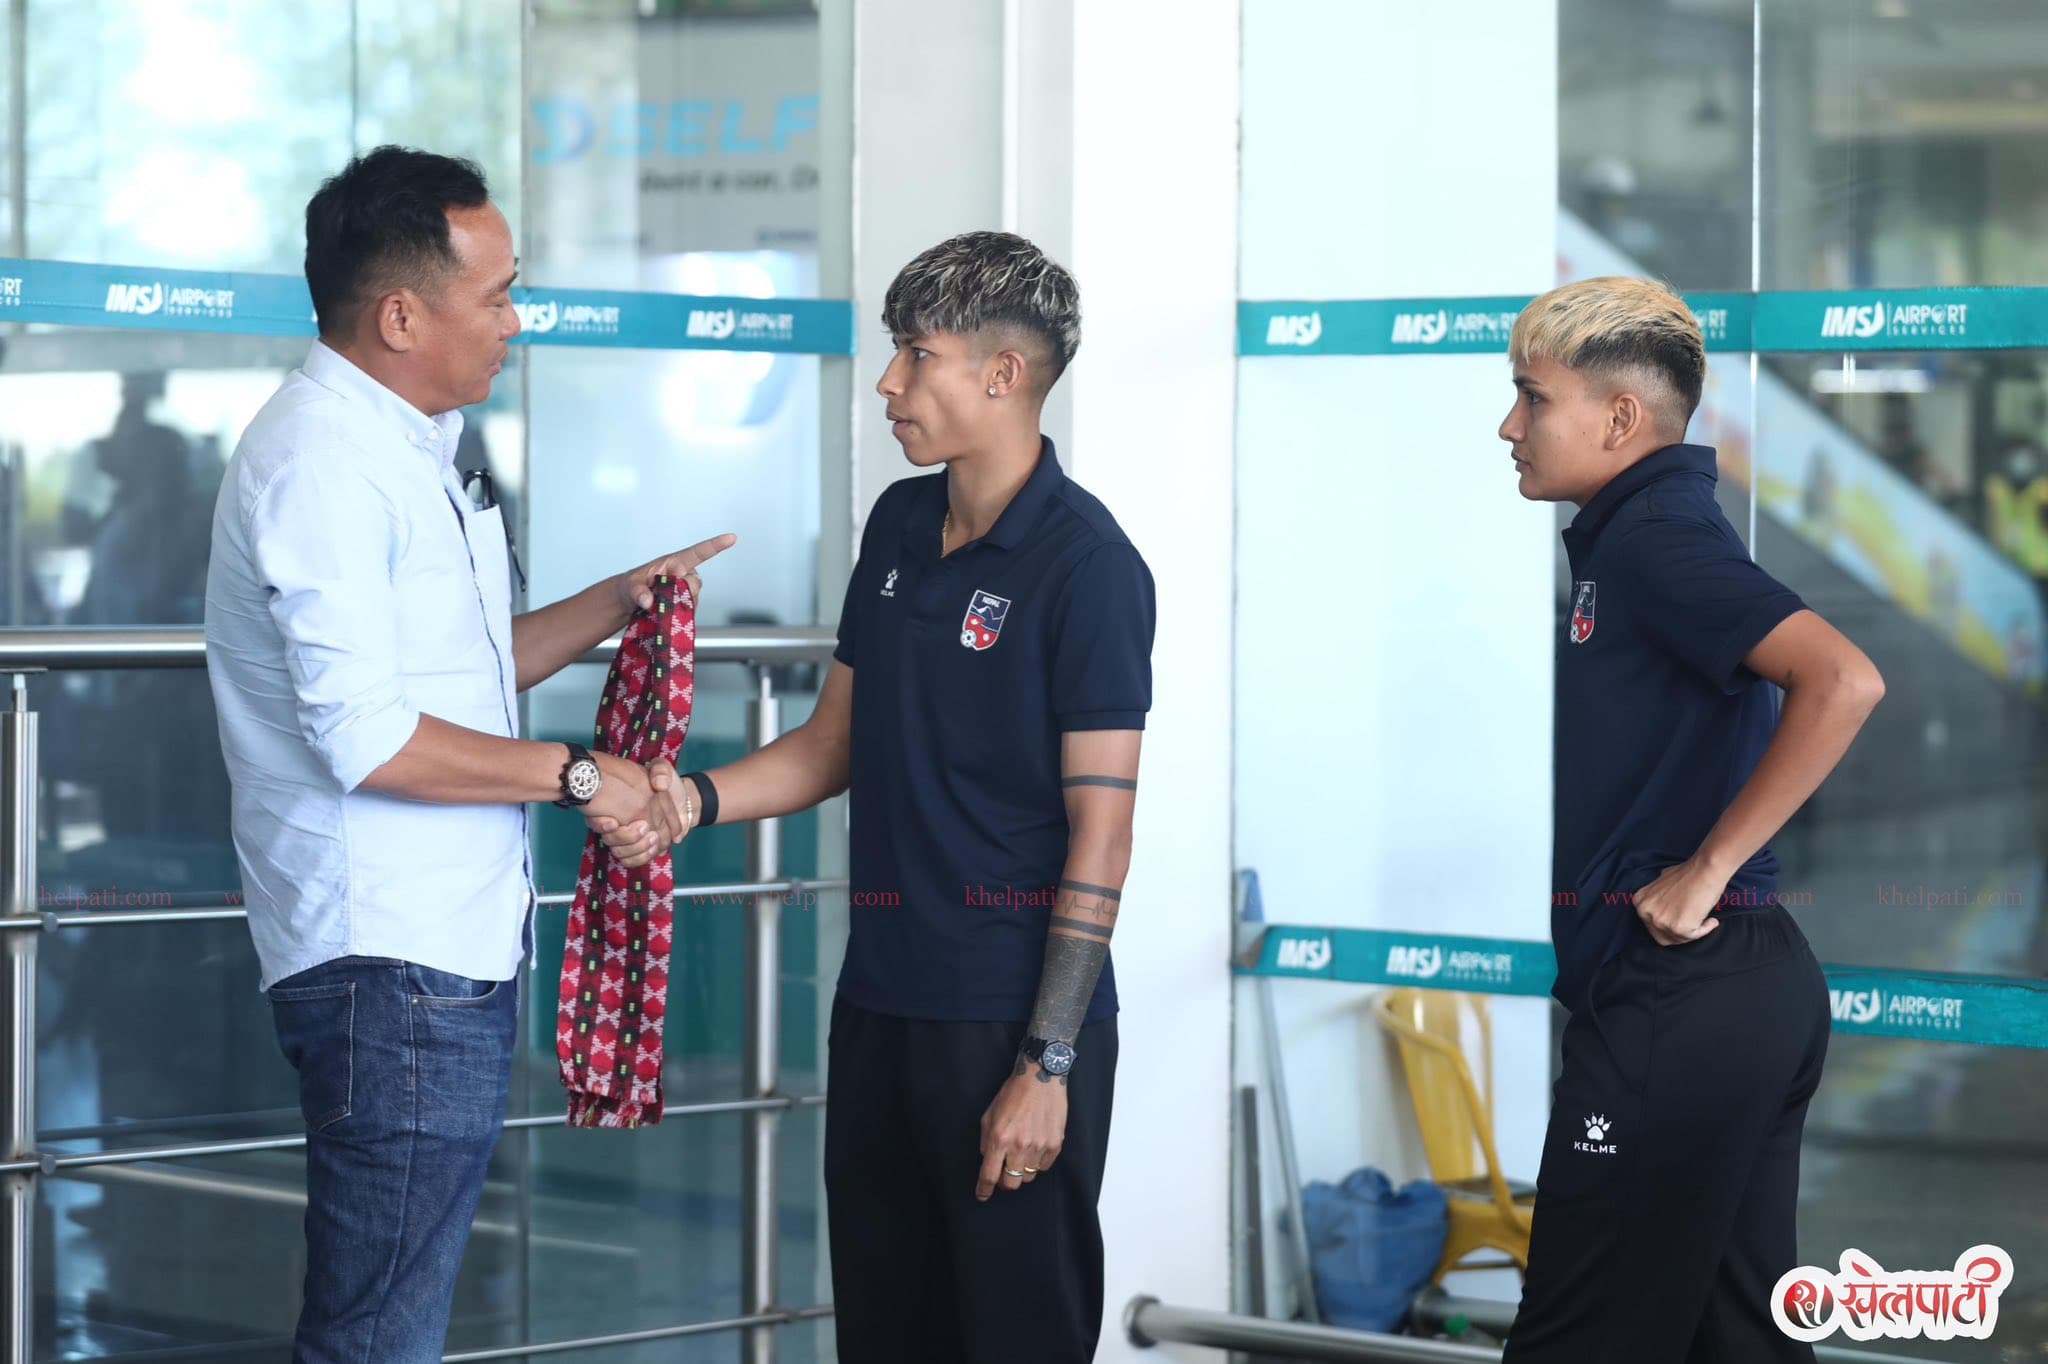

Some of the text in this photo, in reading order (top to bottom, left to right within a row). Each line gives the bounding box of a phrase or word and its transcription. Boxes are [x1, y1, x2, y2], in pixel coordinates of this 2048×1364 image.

[607, 95, 821, 158] SELF
[170, 287, 235, 309] AIRPORT
[1893, 304, 1968, 325] AIRPORT
[1892, 323, 1967, 336] SERVICES
[1830, 988, 1963, 1024] MS AIRPORT
[1888, 1013, 1962, 1031] SERVICES
[1574, 1140, 1617, 1154] KELME
